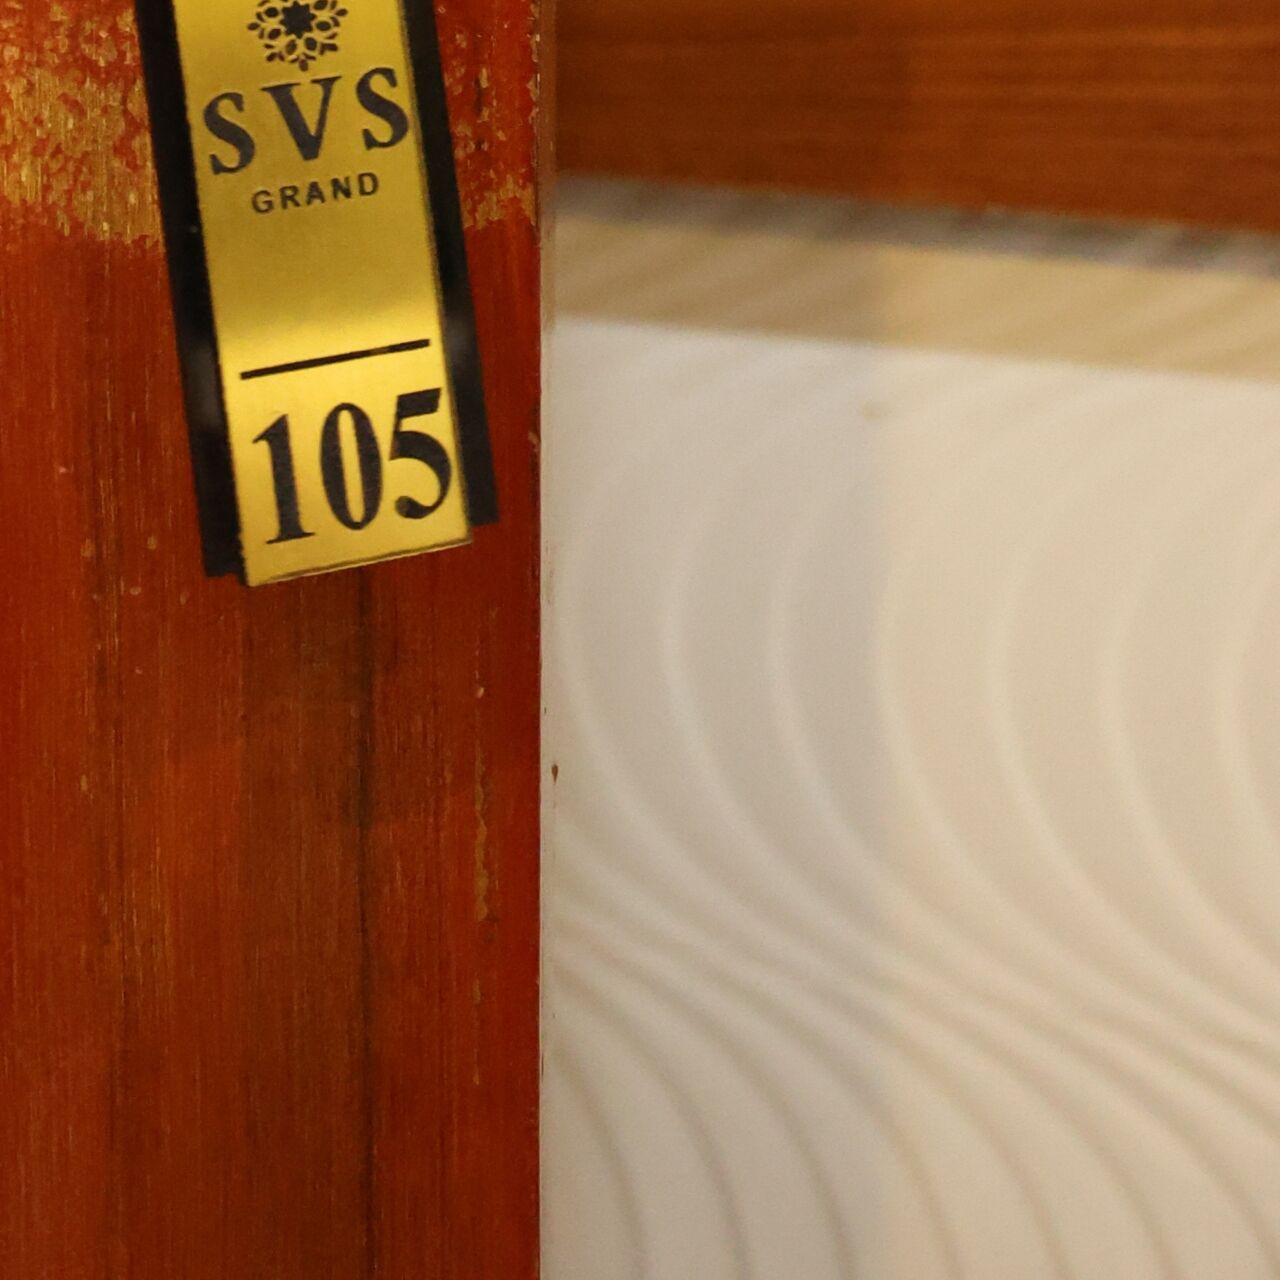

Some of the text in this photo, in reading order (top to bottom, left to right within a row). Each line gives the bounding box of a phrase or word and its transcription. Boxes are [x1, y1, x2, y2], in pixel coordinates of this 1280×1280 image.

[203, 66, 410, 175] SVS
[251, 171, 380, 214] GRAND
[253, 387, 452, 544] 105
